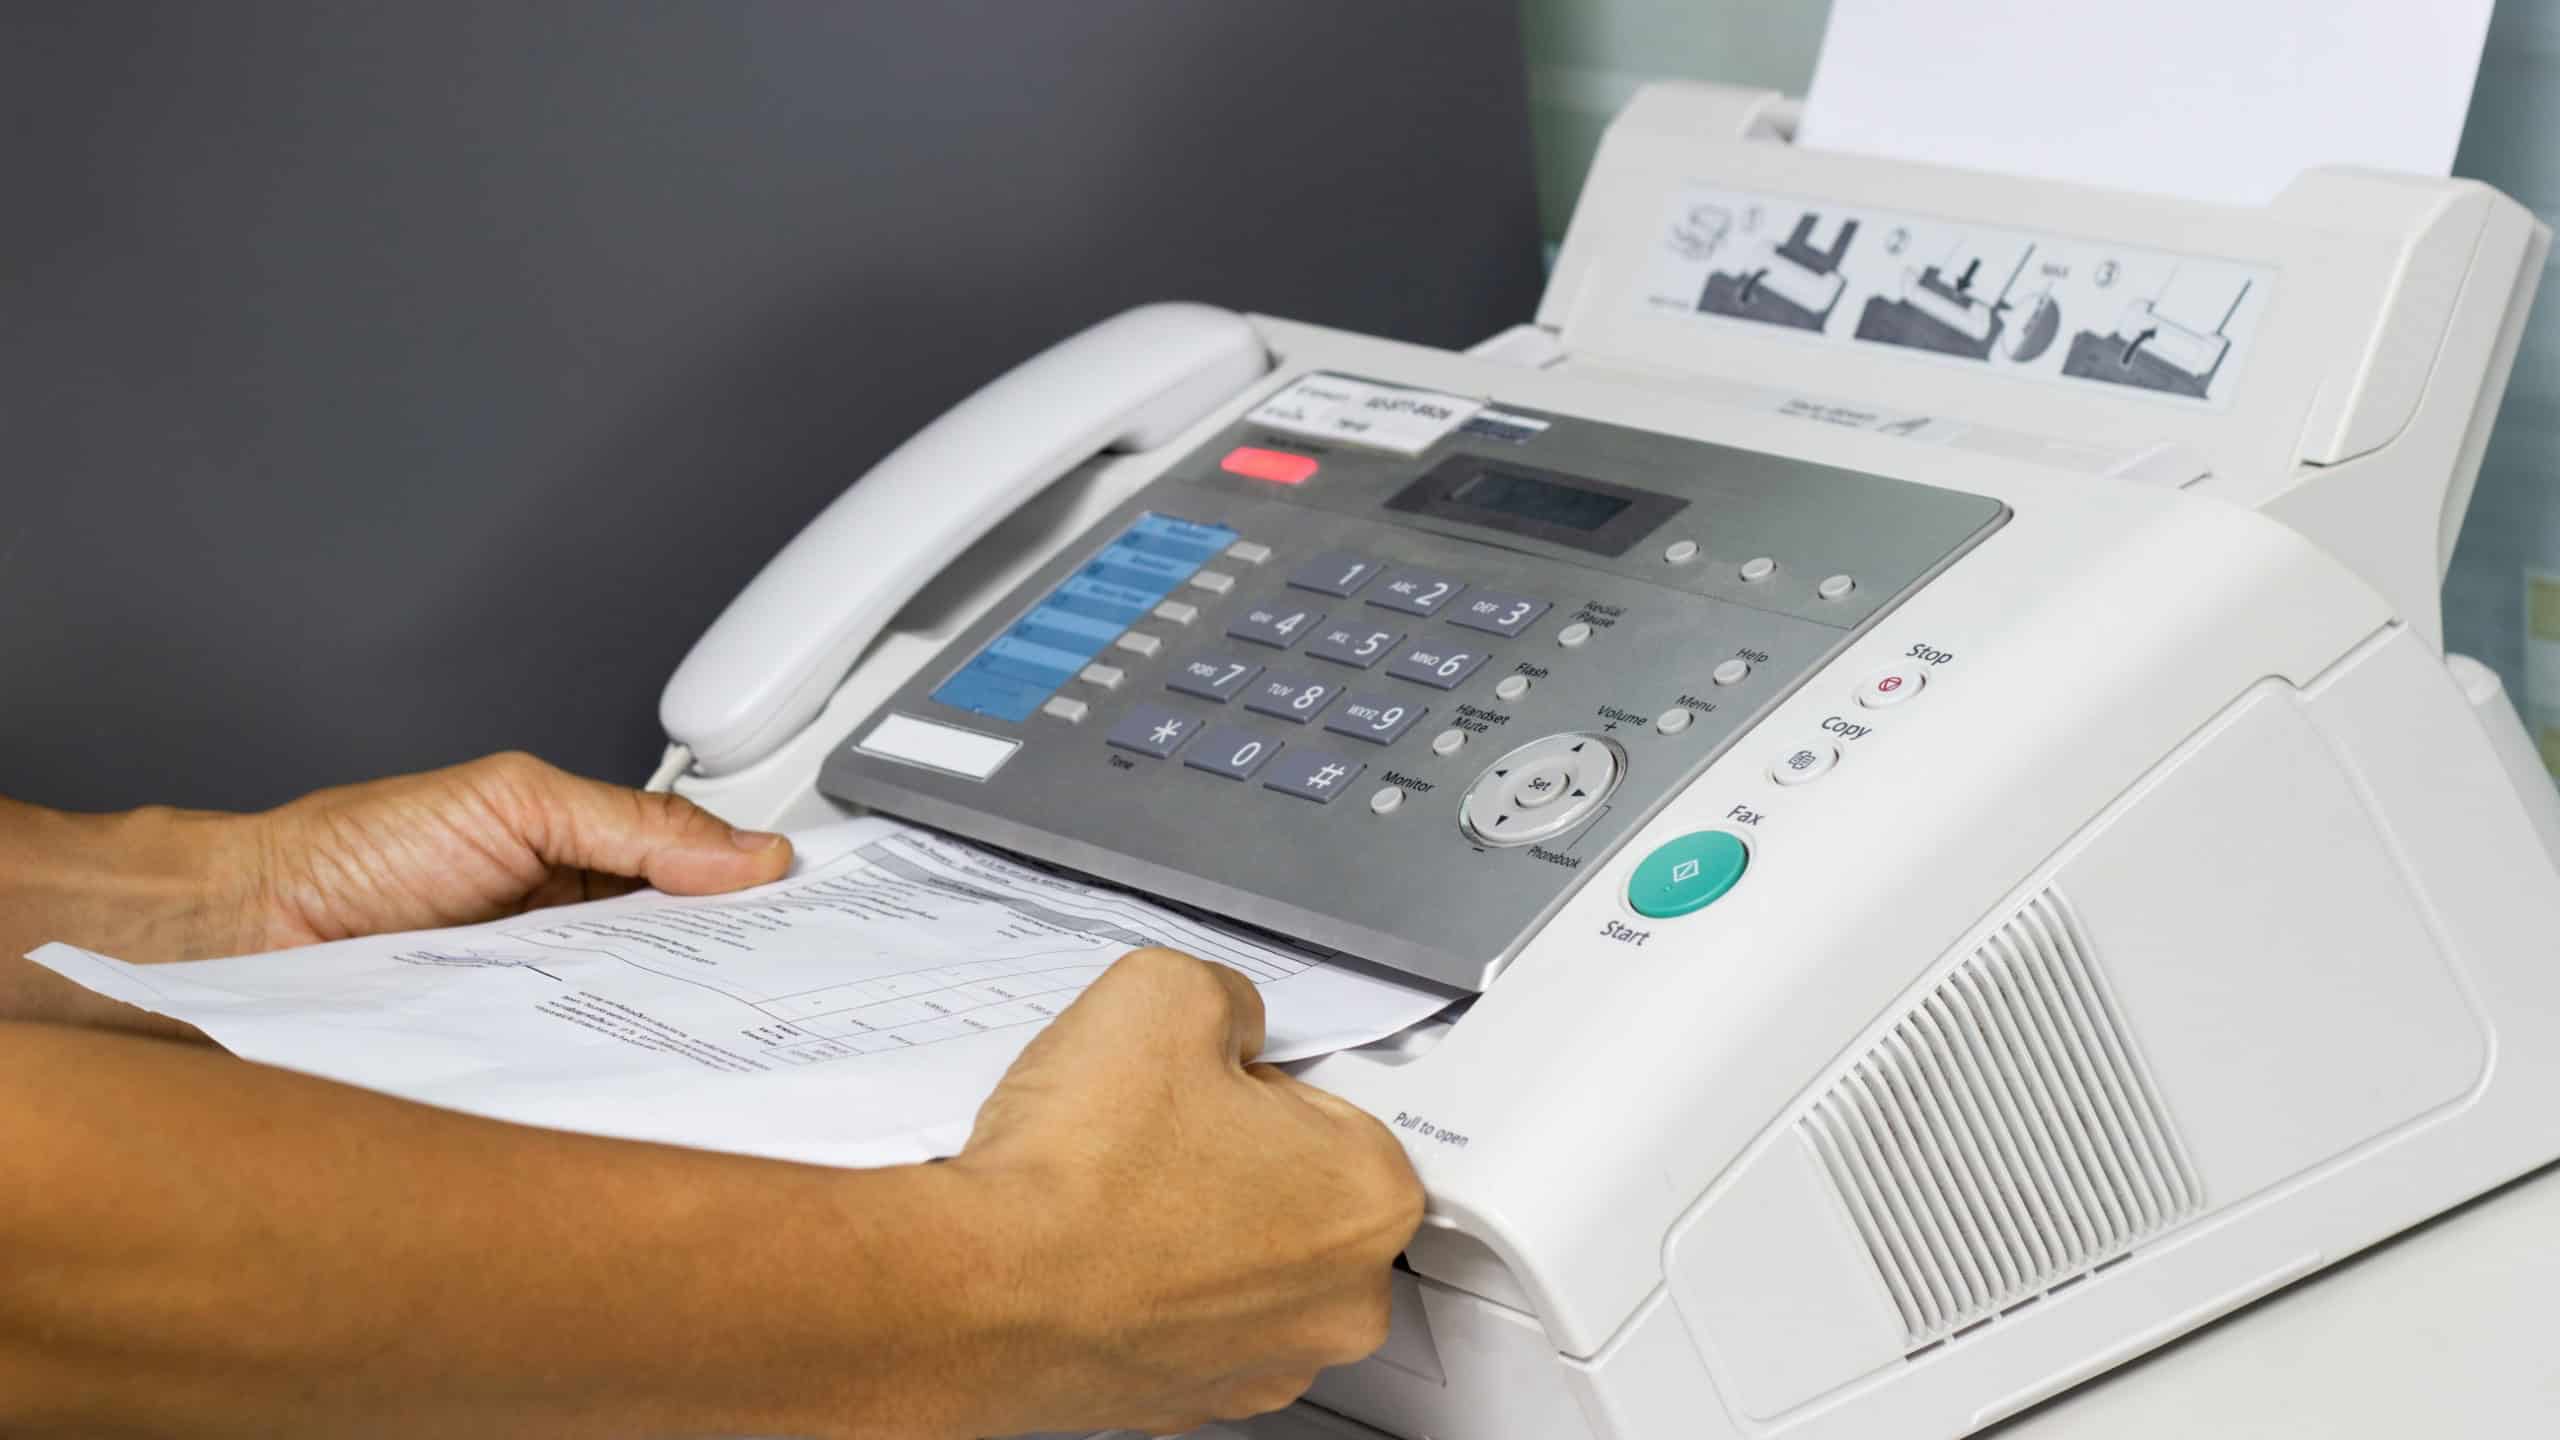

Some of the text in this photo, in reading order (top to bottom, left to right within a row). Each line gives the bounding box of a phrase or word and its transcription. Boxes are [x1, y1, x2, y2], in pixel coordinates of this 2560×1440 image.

[1337, 563, 1366, 586] 1
[1414, 581, 1449, 607] 2
[1274, 612, 1306, 636] 4
[1471, 599, 1532, 626] DEF 3
[1354, 631, 1391, 656] 5
[1735, 646, 1770, 665] Help
[1904, 642, 1954, 667] Stop
[1212, 663, 1247, 688] 7
[1409, 650, 1470, 677] MNO 6
[1513, 660, 1550, 681] Flash
[1292, 685, 1326, 710] 8
[1675, 693, 1719, 714] Menu
[1372, 706, 1405, 731] 9
[1451, 716, 1489, 734] Mute
[1455, 703, 1511, 726] Handset
[1597, 703, 1649, 727] Volume
[1820, 715, 1873, 741] Copy
[1230, 741, 1263, 767] 0
[1305, 761, 1346, 789] #
[1380, 769, 1436, 795] Monitor
[1527, 775, 1553, 793] Set
[1726, 804, 1767, 827] Fax
[1527, 844, 1583, 869] Phonebook
[1599, 919, 1652, 948] Start
[1392, 1111, 1470, 1147] Pull to open
